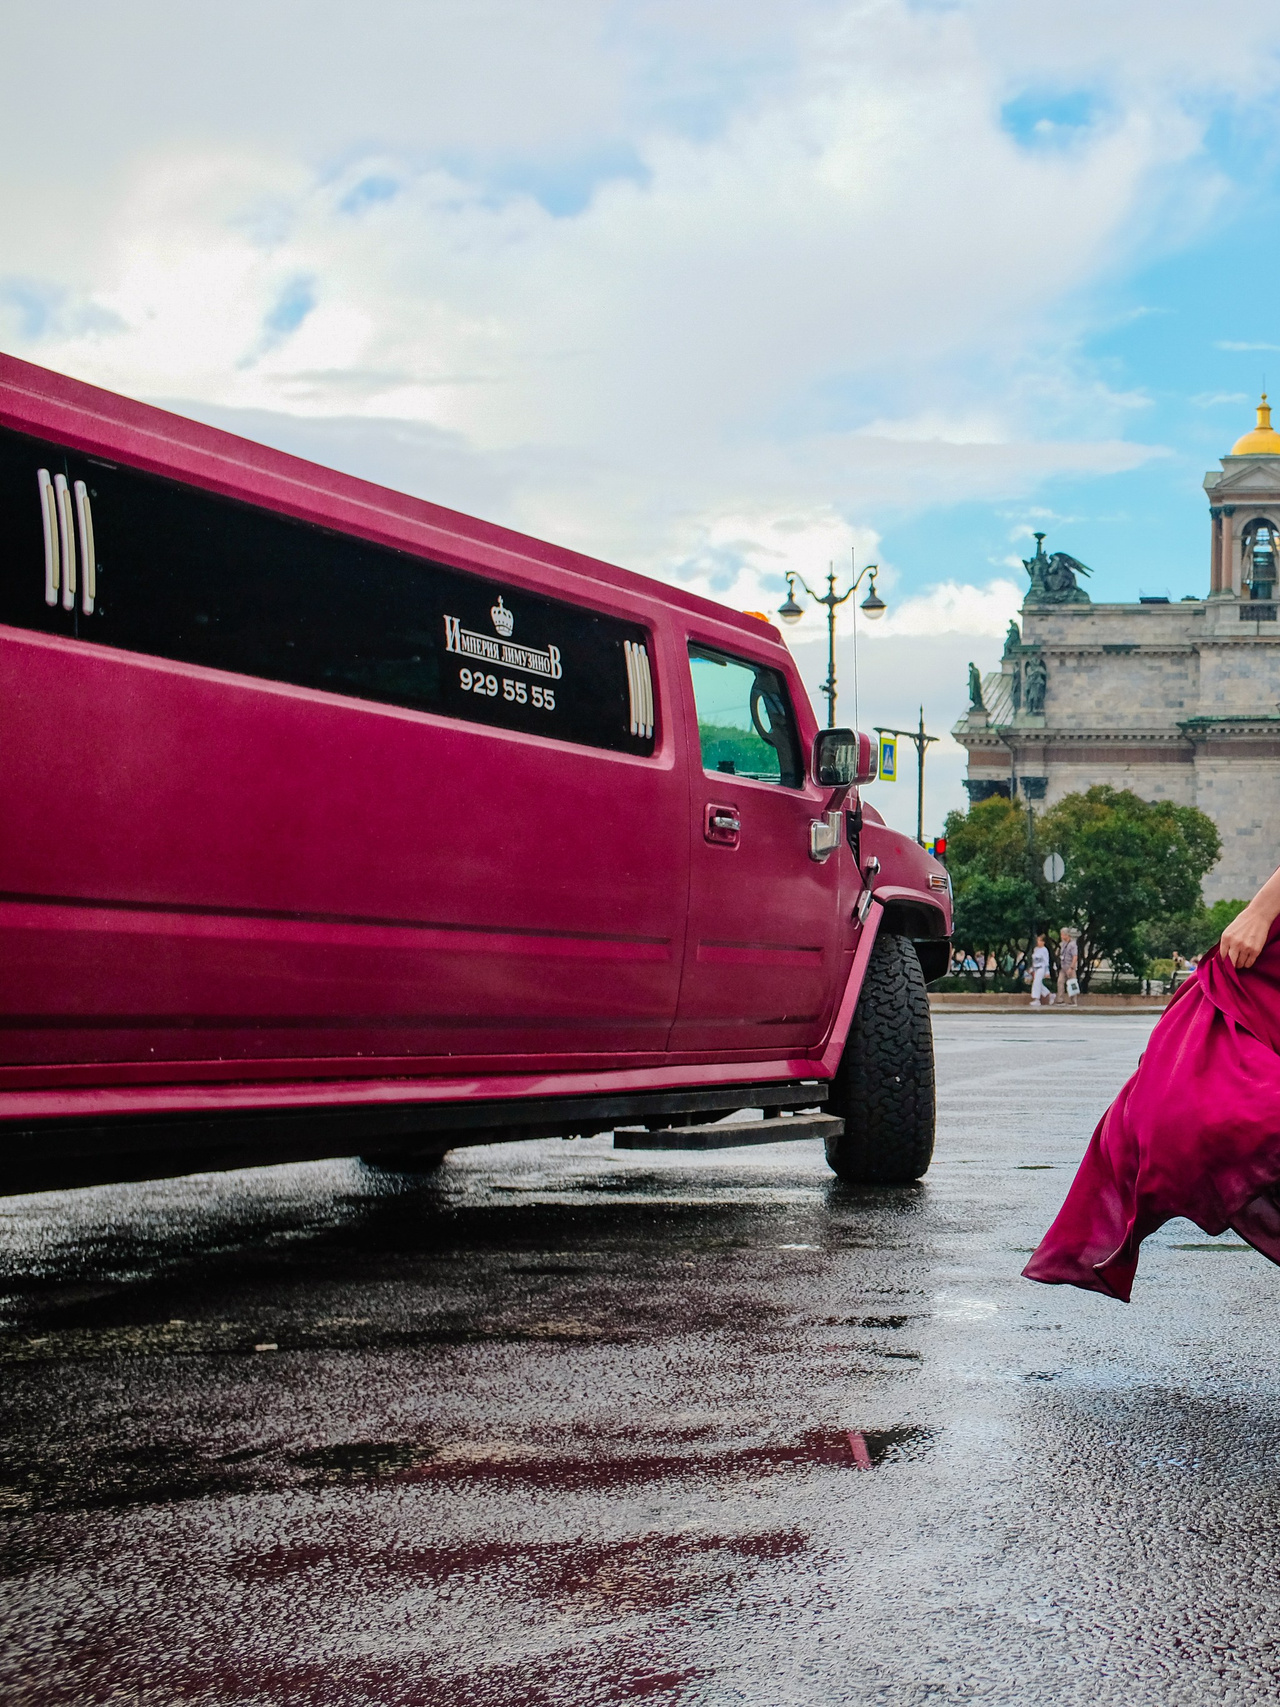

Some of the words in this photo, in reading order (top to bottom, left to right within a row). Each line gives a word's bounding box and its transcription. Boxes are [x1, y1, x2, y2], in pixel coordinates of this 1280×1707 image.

[443, 614, 500, 659] ИМПЕРИЯ
[501, 644, 563, 680] ЛИМУЗИНОВ
[459, 667, 499, 697] 929
[502, 678, 528, 705] 55
[531, 685, 556, 711] 55
